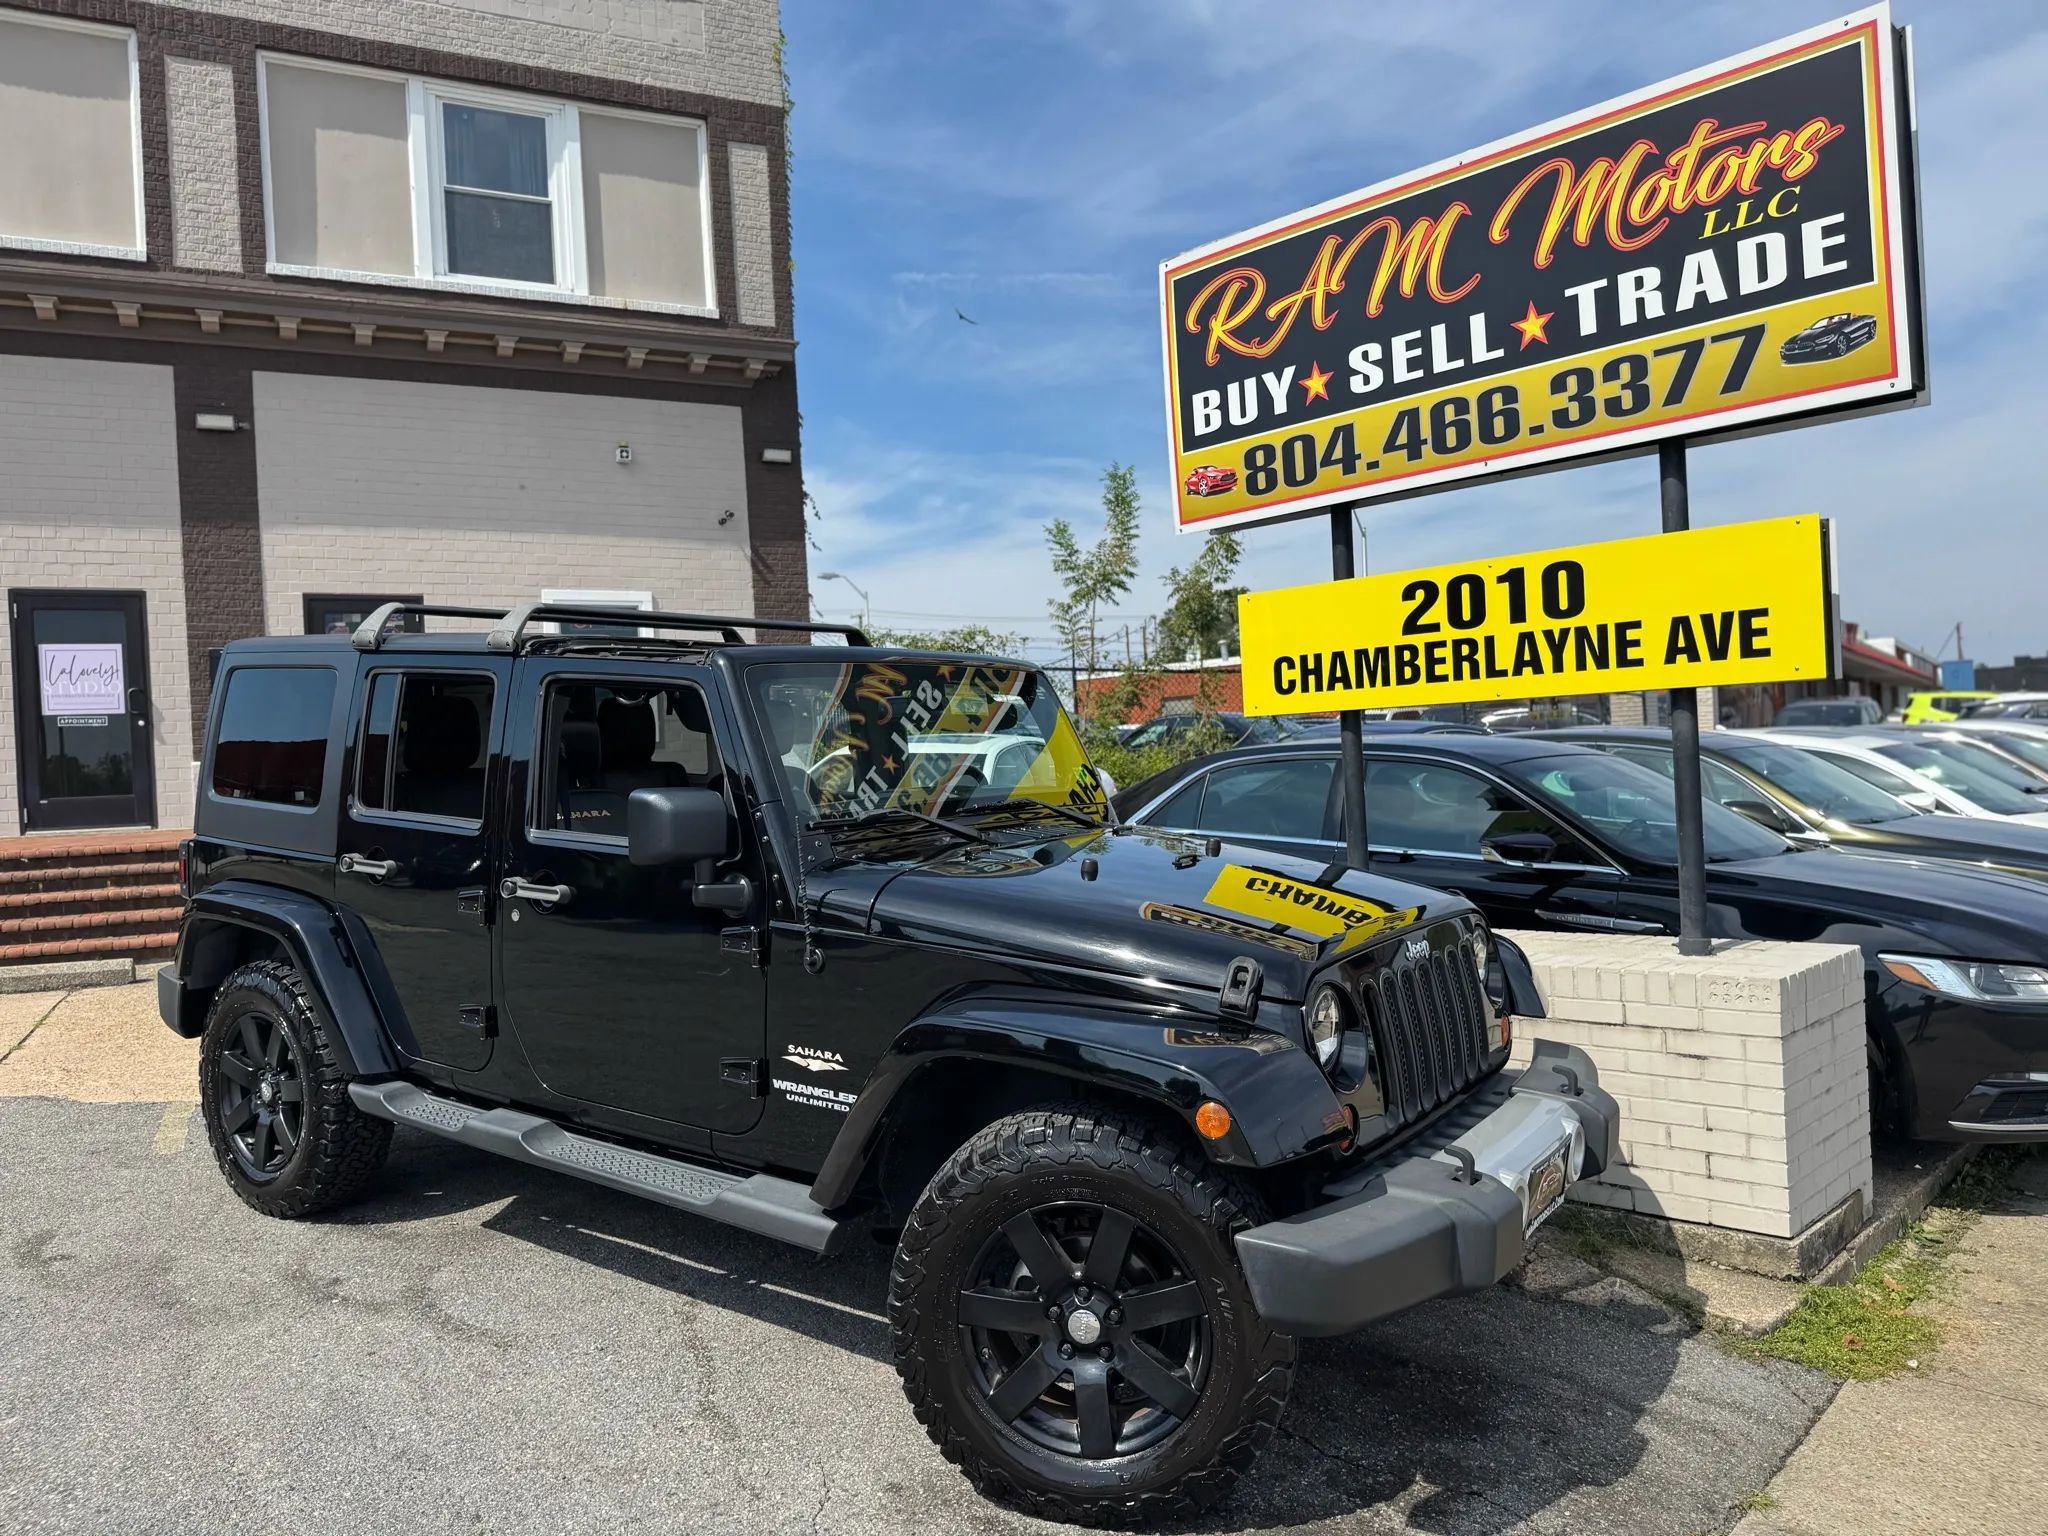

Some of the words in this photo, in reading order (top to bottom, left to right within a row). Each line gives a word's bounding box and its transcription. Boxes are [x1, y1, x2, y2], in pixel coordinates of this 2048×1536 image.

[1186, 201, 1481, 366] RAM
[1489, 117, 1844, 269] Motors
[1698, 185, 1800, 239] LLC
[1192, 365, 1296, 436] BUY
[1348, 312, 1505, 394] SELL
[1564, 212, 1848, 336] TRADE
[1243, 322, 1767, 497] 804.466.3377
[1401, 560, 1586, 636] 2010
[1272, 620, 1645, 696] CHAMBERLAYNE
[1664, 607, 1772, 665] AVE
[1405, 940, 1430, 961] Jeep
[787, 1044, 844, 1062] SAHARA
[786, 1093, 850, 1112] UNLIMITED
